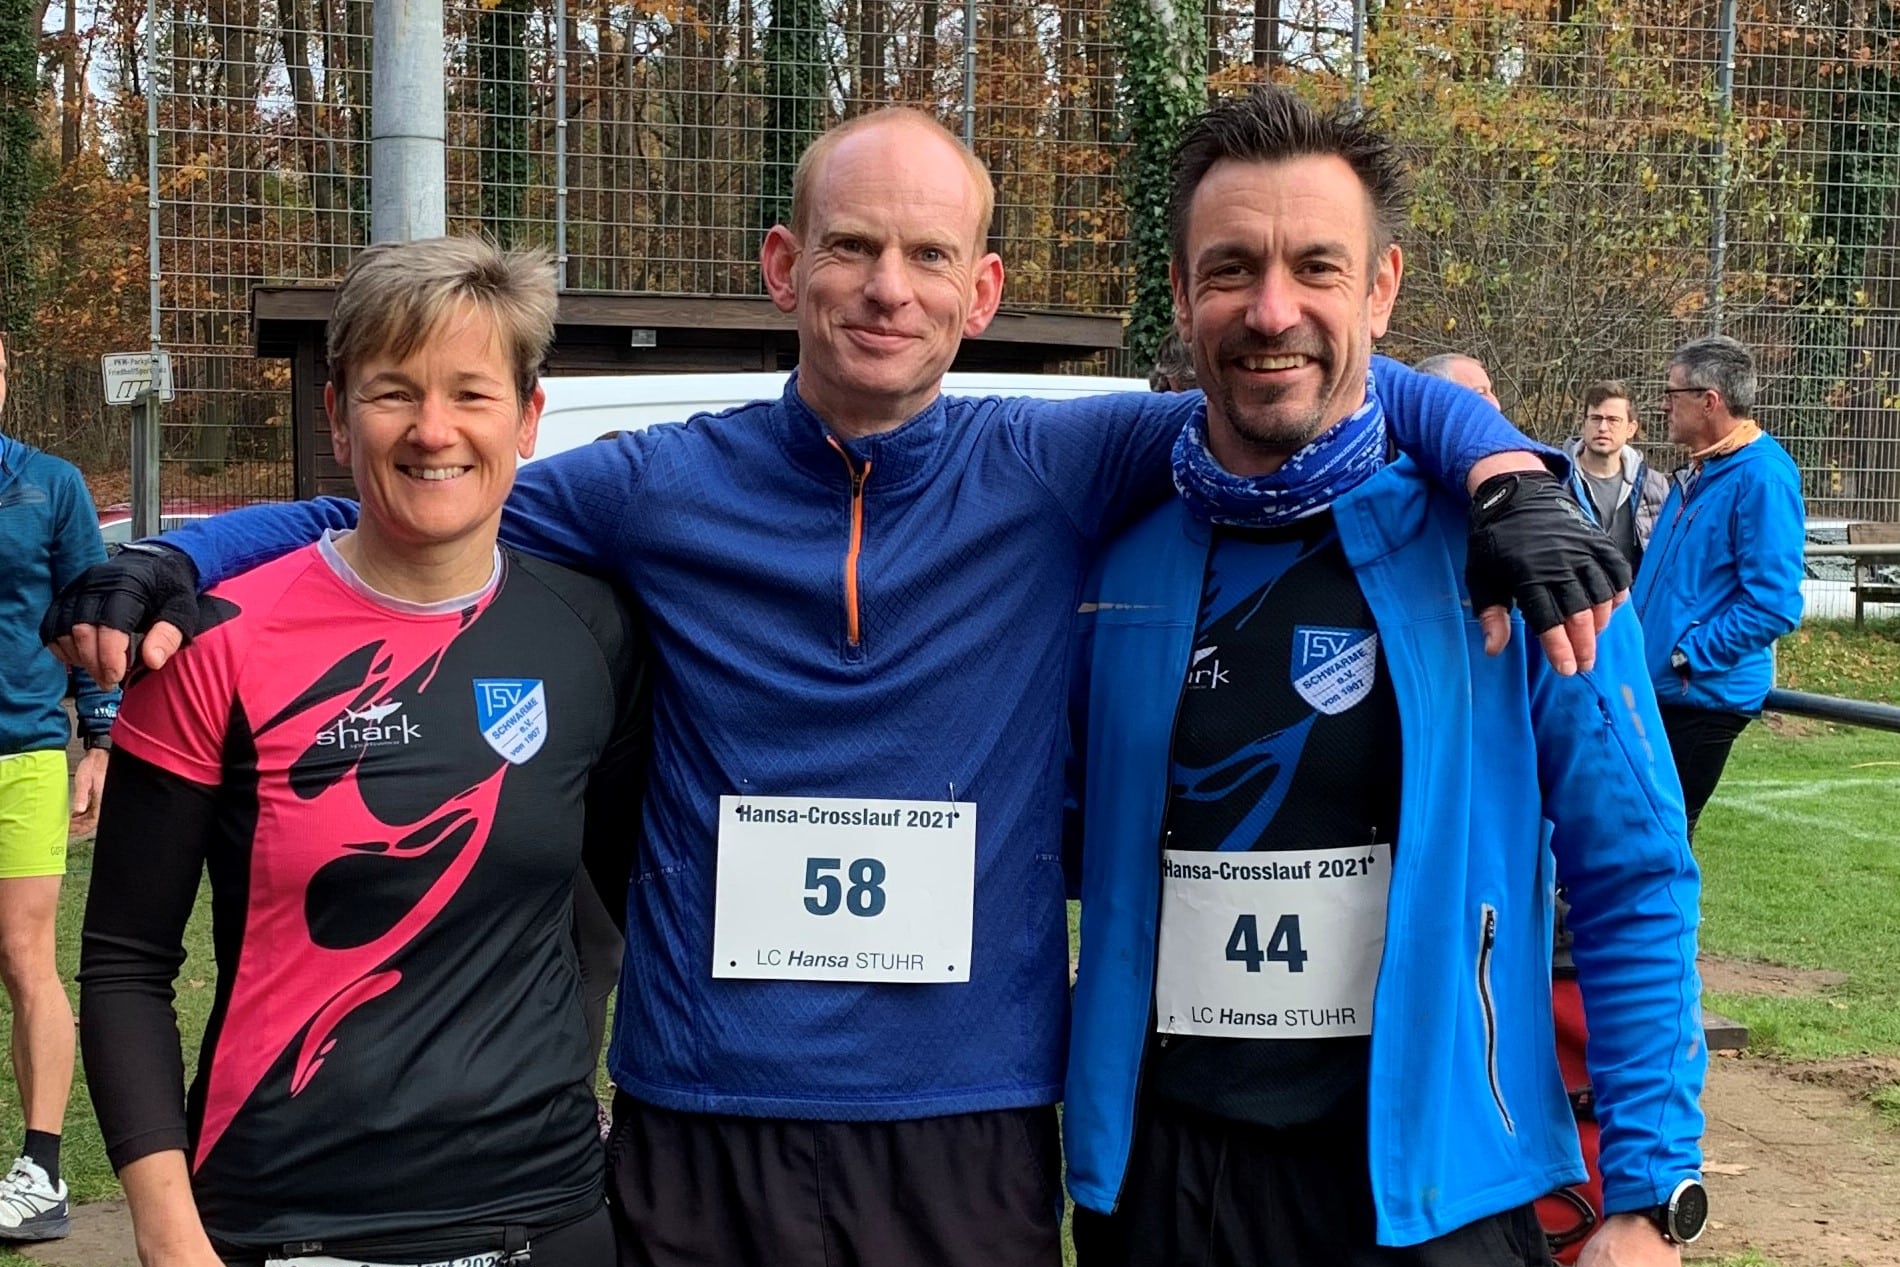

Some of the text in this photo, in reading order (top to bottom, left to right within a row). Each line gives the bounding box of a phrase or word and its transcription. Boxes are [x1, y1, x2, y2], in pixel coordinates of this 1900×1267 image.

[1298, 629, 1352, 666] TSV
[1302, 648, 1368, 689] SCHWARME
[1337, 670, 1355, 685] e.V.
[478, 683, 522, 717] TSV
[1321, 679, 1364, 707] von 1907
[316, 714, 422, 749] shark
[492, 697, 538, 739] SCHWARME
[520, 719, 534, 734] e.V.
[739, 805, 954, 829] Hansa-Crosslauf 2021
[1164, 857, 1369, 880] Hansa-Crosslauf 2021
[804, 857, 886, 917] 58
[1225, 914, 1308, 972] 44
[757, 949, 924, 970] LC Hansa STUHR
[1192, 1006, 1357, 1026] LC Hansa STUHR
